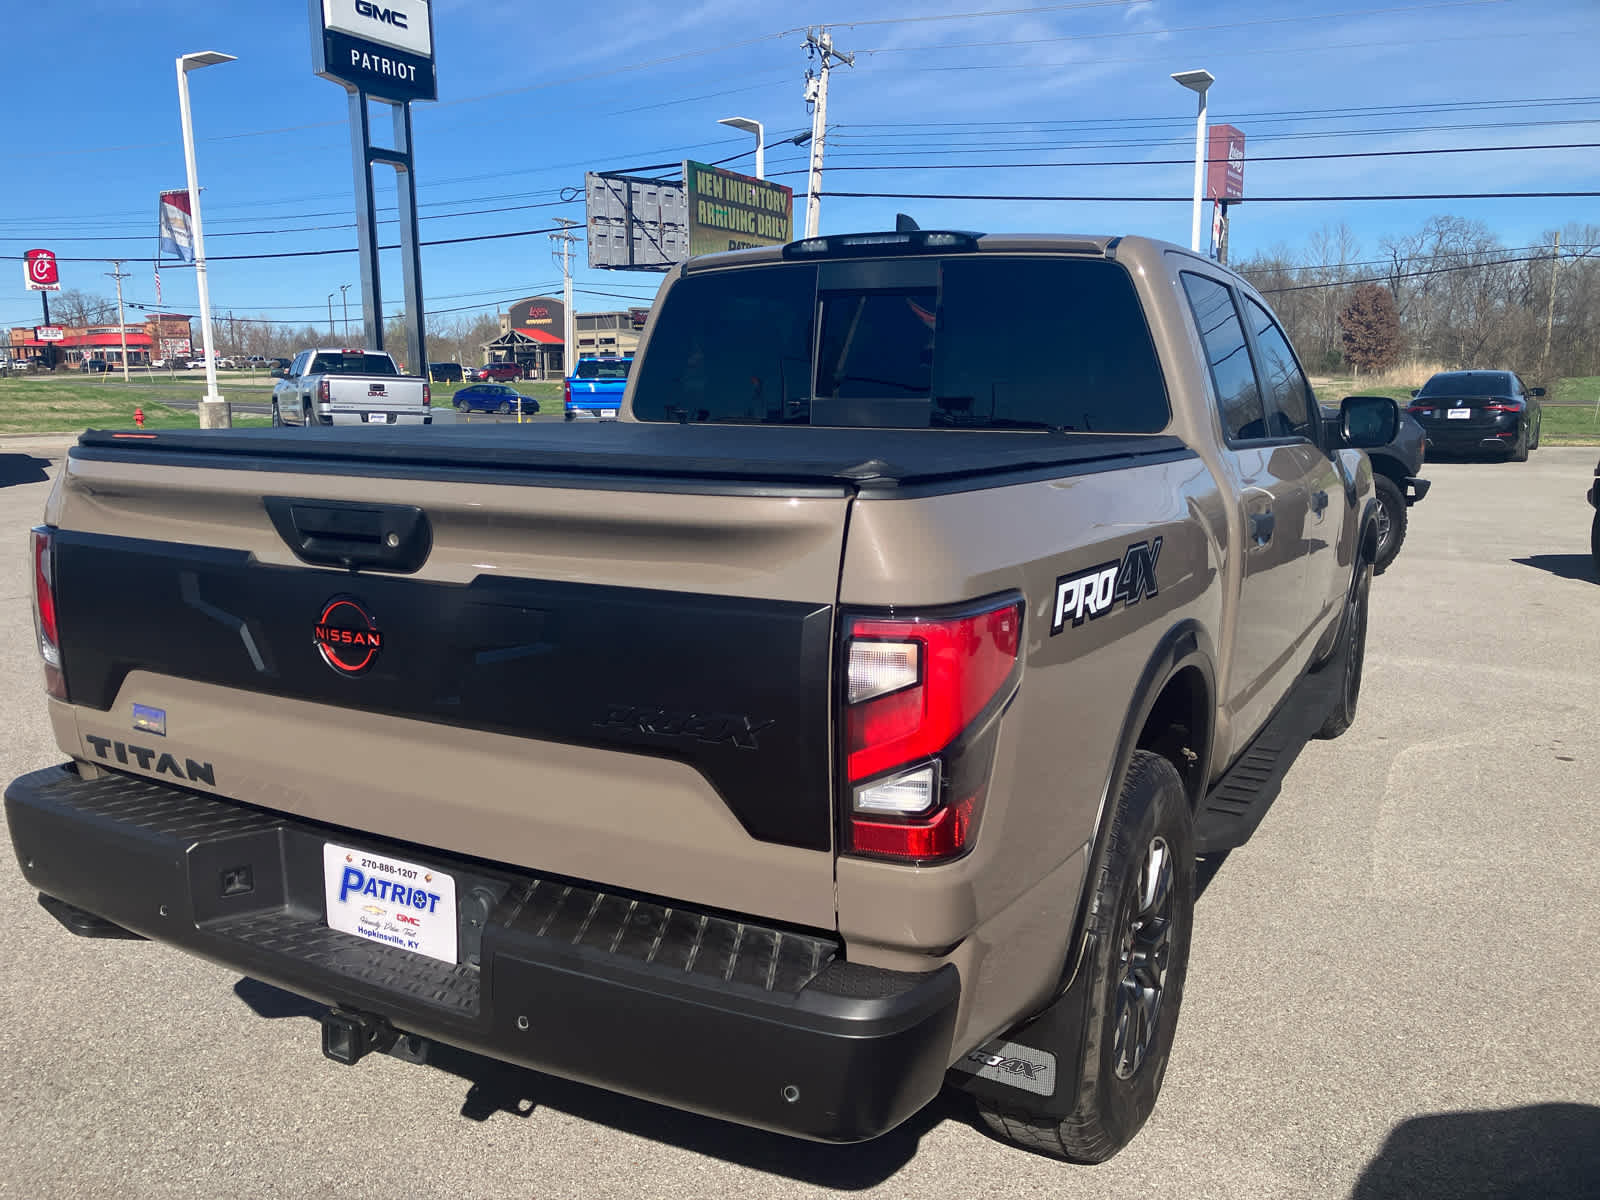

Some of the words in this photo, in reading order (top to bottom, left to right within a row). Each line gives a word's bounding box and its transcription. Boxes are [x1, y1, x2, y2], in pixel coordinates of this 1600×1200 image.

[355, 0, 408, 29] GMC
[351, 49, 416, 82] PATRIOT
[696, 170, 723, 200] NEW
[725, 178, 787, 214] INVENTORY
[698, 200, 756, 234] ARRIVING
[315, 626, 381, 646] NISSAN
[86, 734, 216, 786] TITAN
[396, 913, 421, 927] GMC
[357, 926, 406, 947] Hopkinsville,
[407, 940, 420, 950] KY
